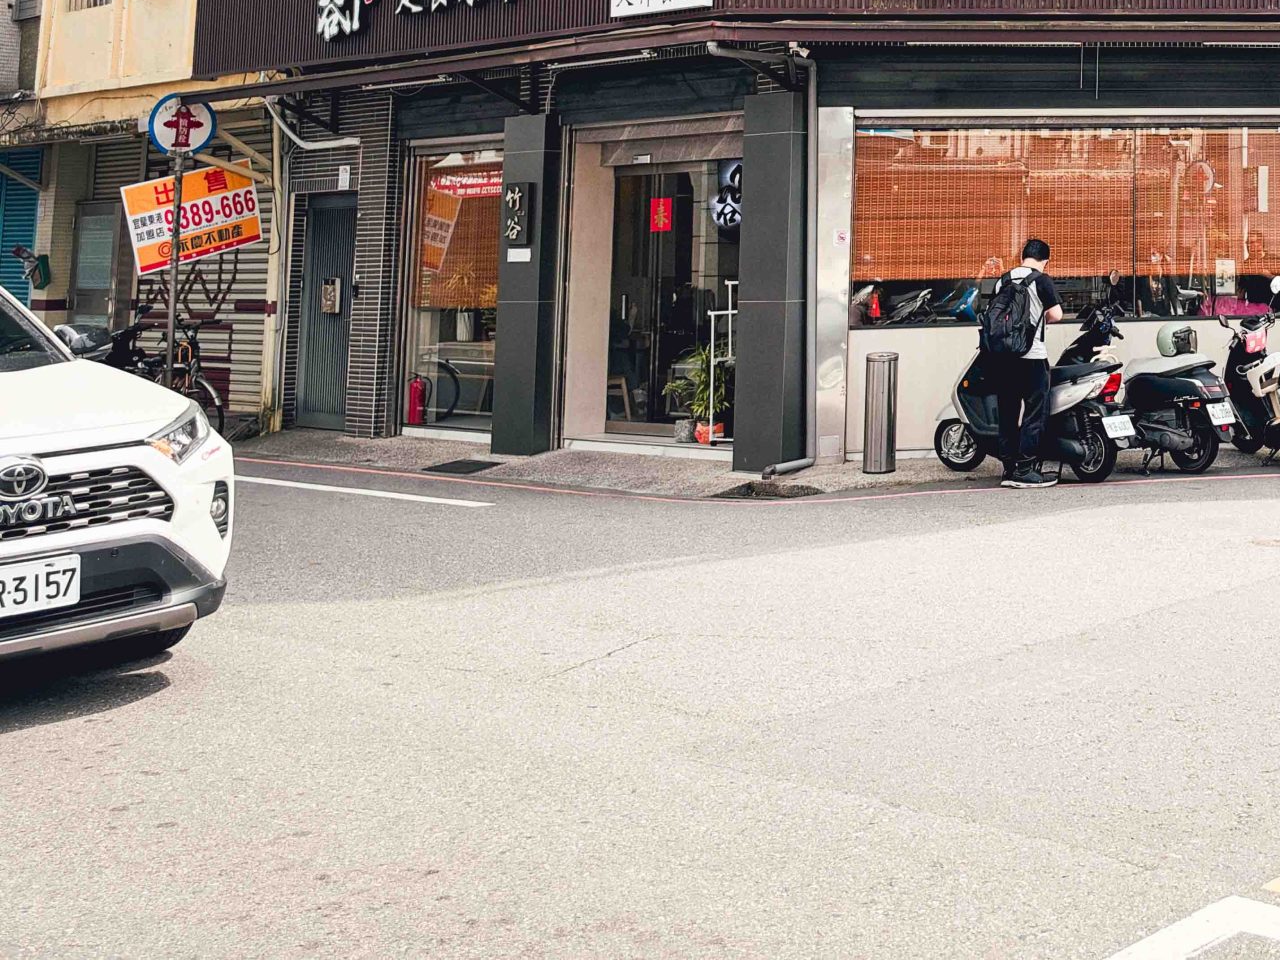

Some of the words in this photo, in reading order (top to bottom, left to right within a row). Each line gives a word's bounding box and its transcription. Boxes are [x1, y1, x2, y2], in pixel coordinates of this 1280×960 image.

[164, 190, 256, 232] 9389-666
[504, 186, 522, 240] 竹谷
[136, 227, 166, 243] 加盟店
[0, 494, 77, 525] YOTA
